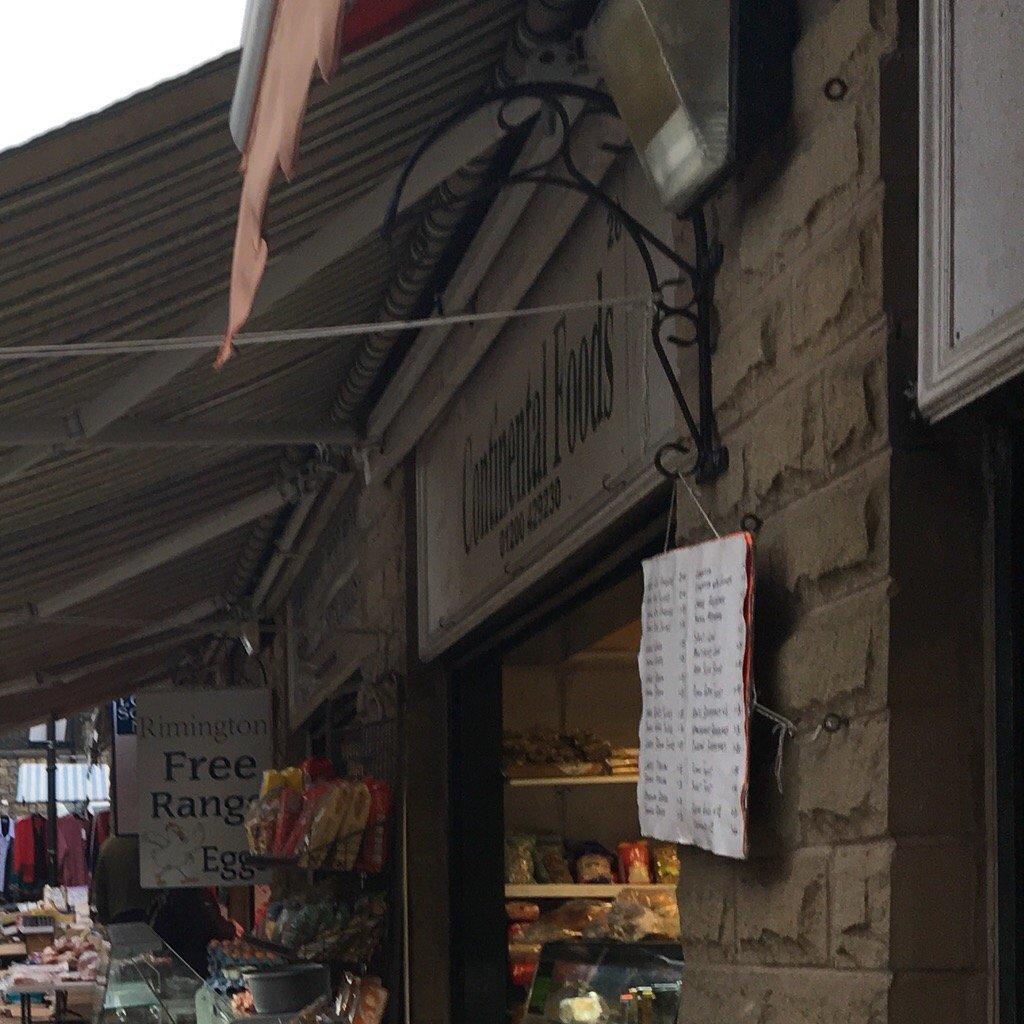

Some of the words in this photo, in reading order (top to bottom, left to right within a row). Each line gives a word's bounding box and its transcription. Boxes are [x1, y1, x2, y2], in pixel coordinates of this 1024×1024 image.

[461, 338, 548, 555] Continental
[553, 268, 614, 466] Foods
[139, 714, 268, 743] Rimington
[163, 750, 257, 781] Free
[202, 845, 267, 880] Egg
